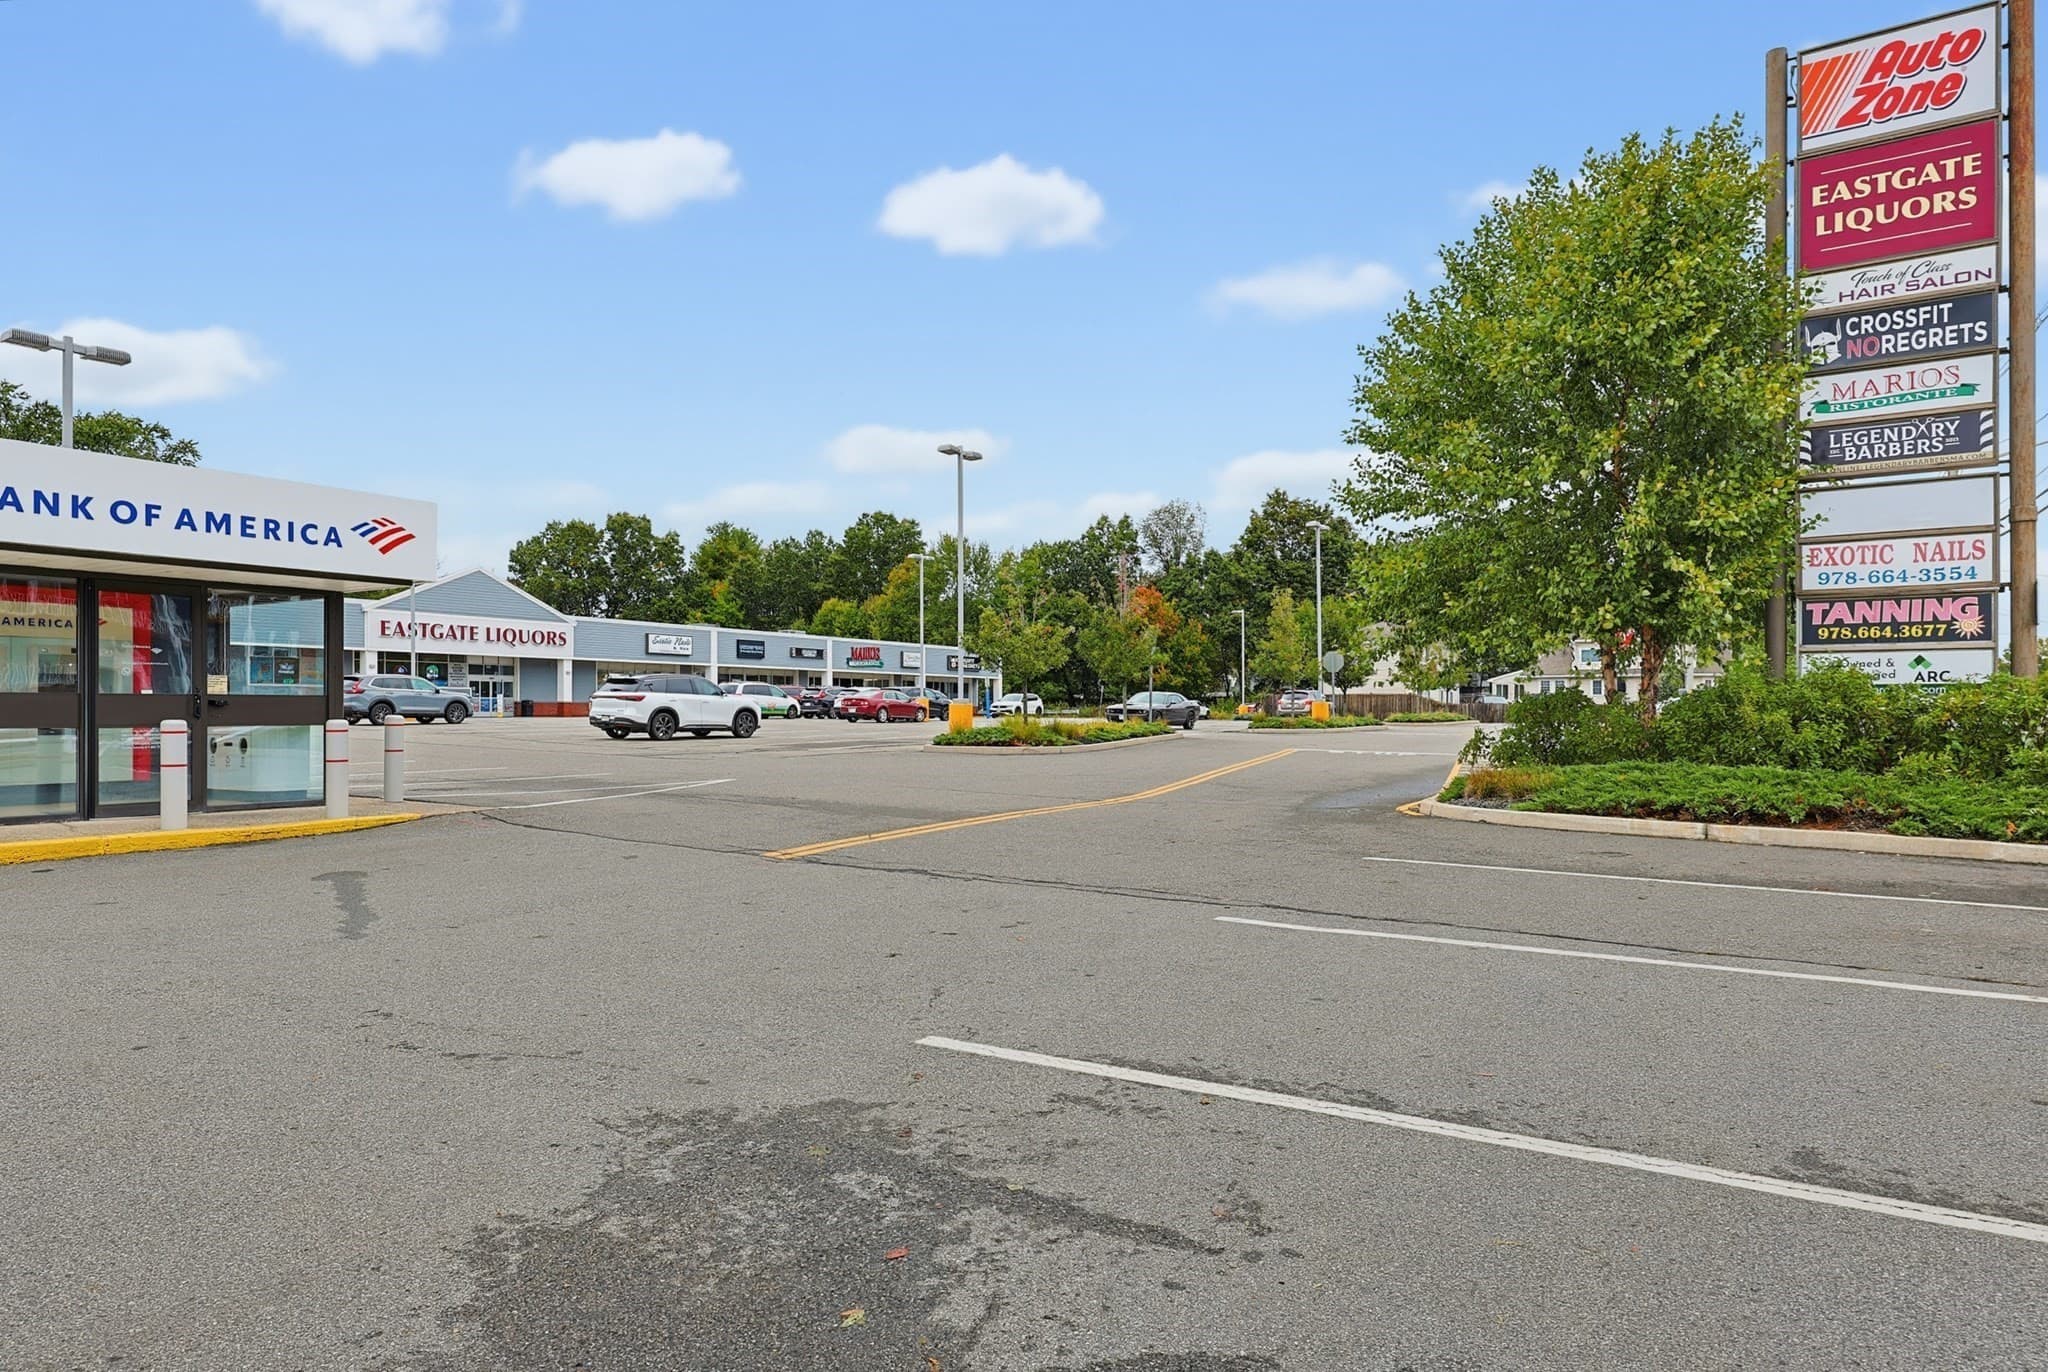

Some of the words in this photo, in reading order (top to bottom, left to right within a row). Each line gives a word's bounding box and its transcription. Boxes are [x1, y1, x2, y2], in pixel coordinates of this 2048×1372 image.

[1859, 27, 1986, 86] Auto
[1835, 71, 1967, 129] Zone
[1812, 152, 1982, 207] EASTGATE
[1815, 186, 1977, 236] LIQUORS
[1839, 283, 1895, 302] HAIR
[1905, 268, 1992, 292] SALON
[1850, 269, 1892, 288] Touch
[1895, 264, 1912, 285] of
[1911, 260, 1952, 279] Class
[1845, 302, 1953, 336] CROSSFIT
[1832, 365, 1960, 401] MARIOS
[1830, 387, 1958, 413] RISTORANTE
[1844, 437, 1944, 461] BARBERS
[0, 486, 94, 520] ANK
[110, 499, 162, 526] OF
[175, 508, 343, 548] AMERICA
[1808, 543, 1894, 567] EXOTIC
[1913, 539, 1986, 563] NAILS
[1817, 565, 1978, 585] 978-664-3554
[1, 616, 73, 628] AMERICA
[1806, 596, 1979, 625] TANNING
[380, 619, 479, 641] EASTGATE
[486, 627, 567, 647] LIQUORS
[1817, 624, 1948, 640] 978.664.3677
[1886, 657, 1896, 668] &
[1914, 670, 1951, 682] ARC
